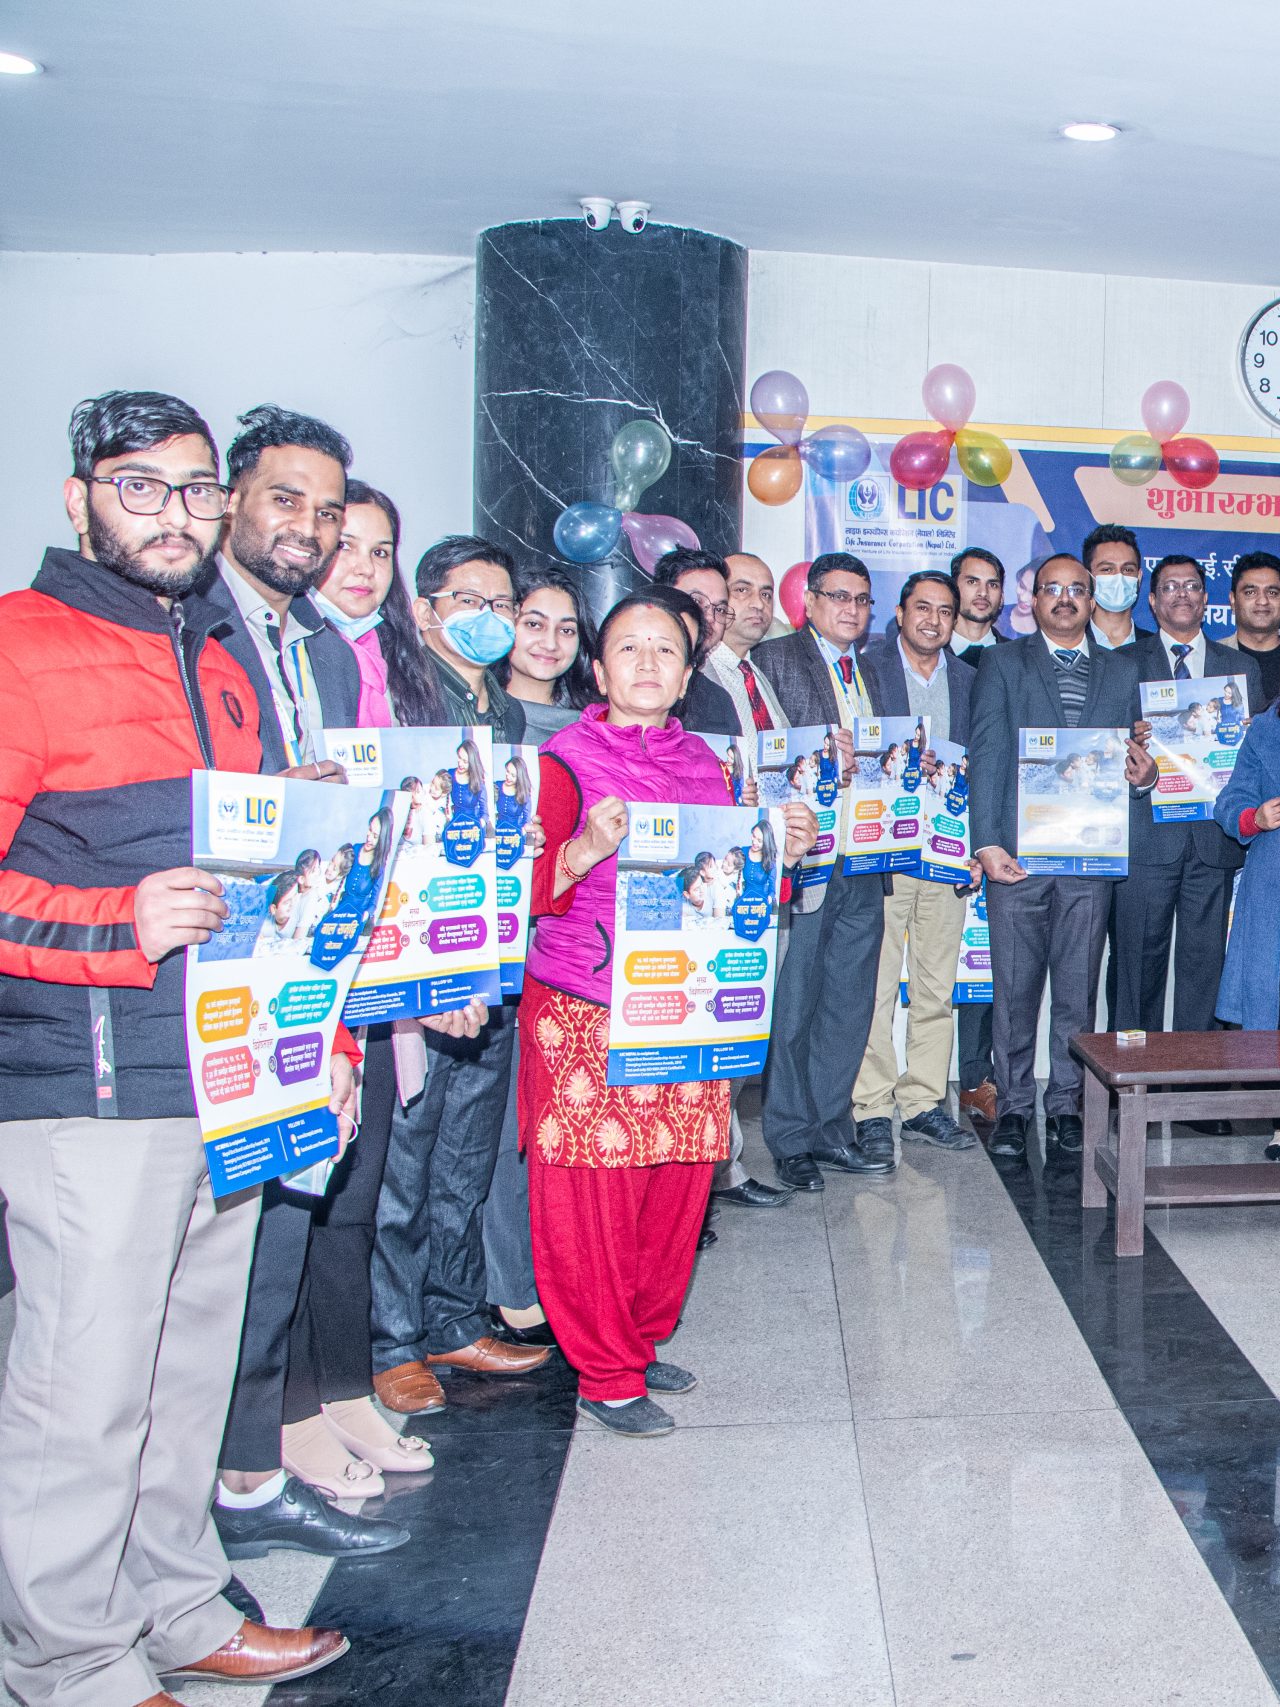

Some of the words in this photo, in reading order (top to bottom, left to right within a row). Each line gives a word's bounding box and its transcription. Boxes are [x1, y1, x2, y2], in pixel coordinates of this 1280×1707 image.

[1260, 331, 1278, 346] 10
[1254, 353, 1265, 368] 9
[1259, 378, 1271, 393] 8
[897, 481, 954, 522] LIC
[845, 537, 855, 546] Life
[856, 537, 886, 547] Insurance
[1160, 687, 1174, 698] LIC
[869, 726, 880, 737] LIC
[774, 738, 786, 750] LIC
[1039, 735, 1054, 746] LIC
[353, 744, 377, 763] LIC
[246, 797, 277, 825] LIC
[653, 818, 674, 837] LIC
